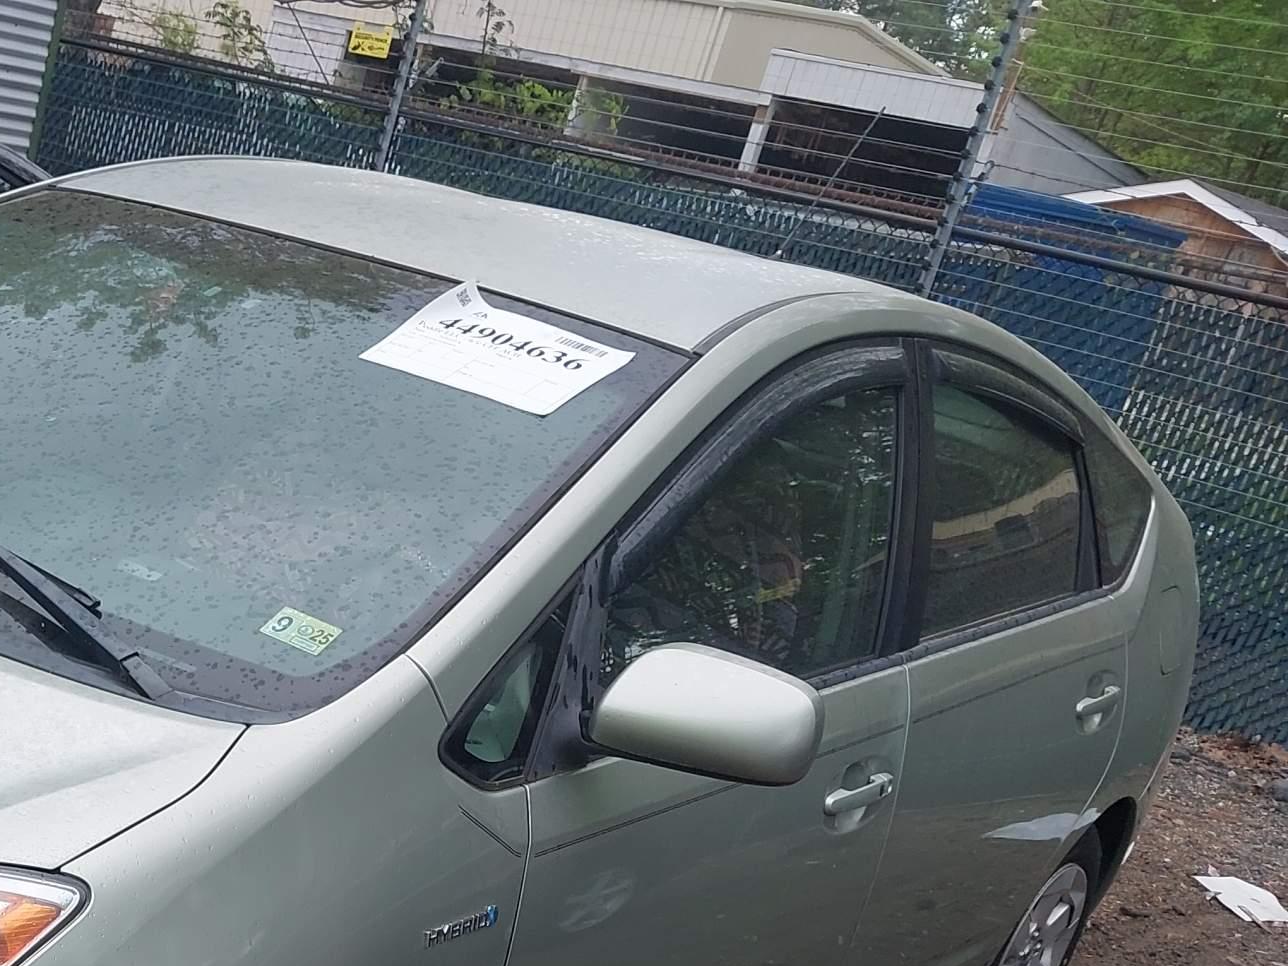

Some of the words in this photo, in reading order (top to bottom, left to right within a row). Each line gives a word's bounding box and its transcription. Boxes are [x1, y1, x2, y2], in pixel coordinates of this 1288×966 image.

[439, 317, 584, 371] 44904636
[271, 616, 294, 632] 9
[309, 629, 334, 645] 25
[424, 911, 489, 948] HYBRID
